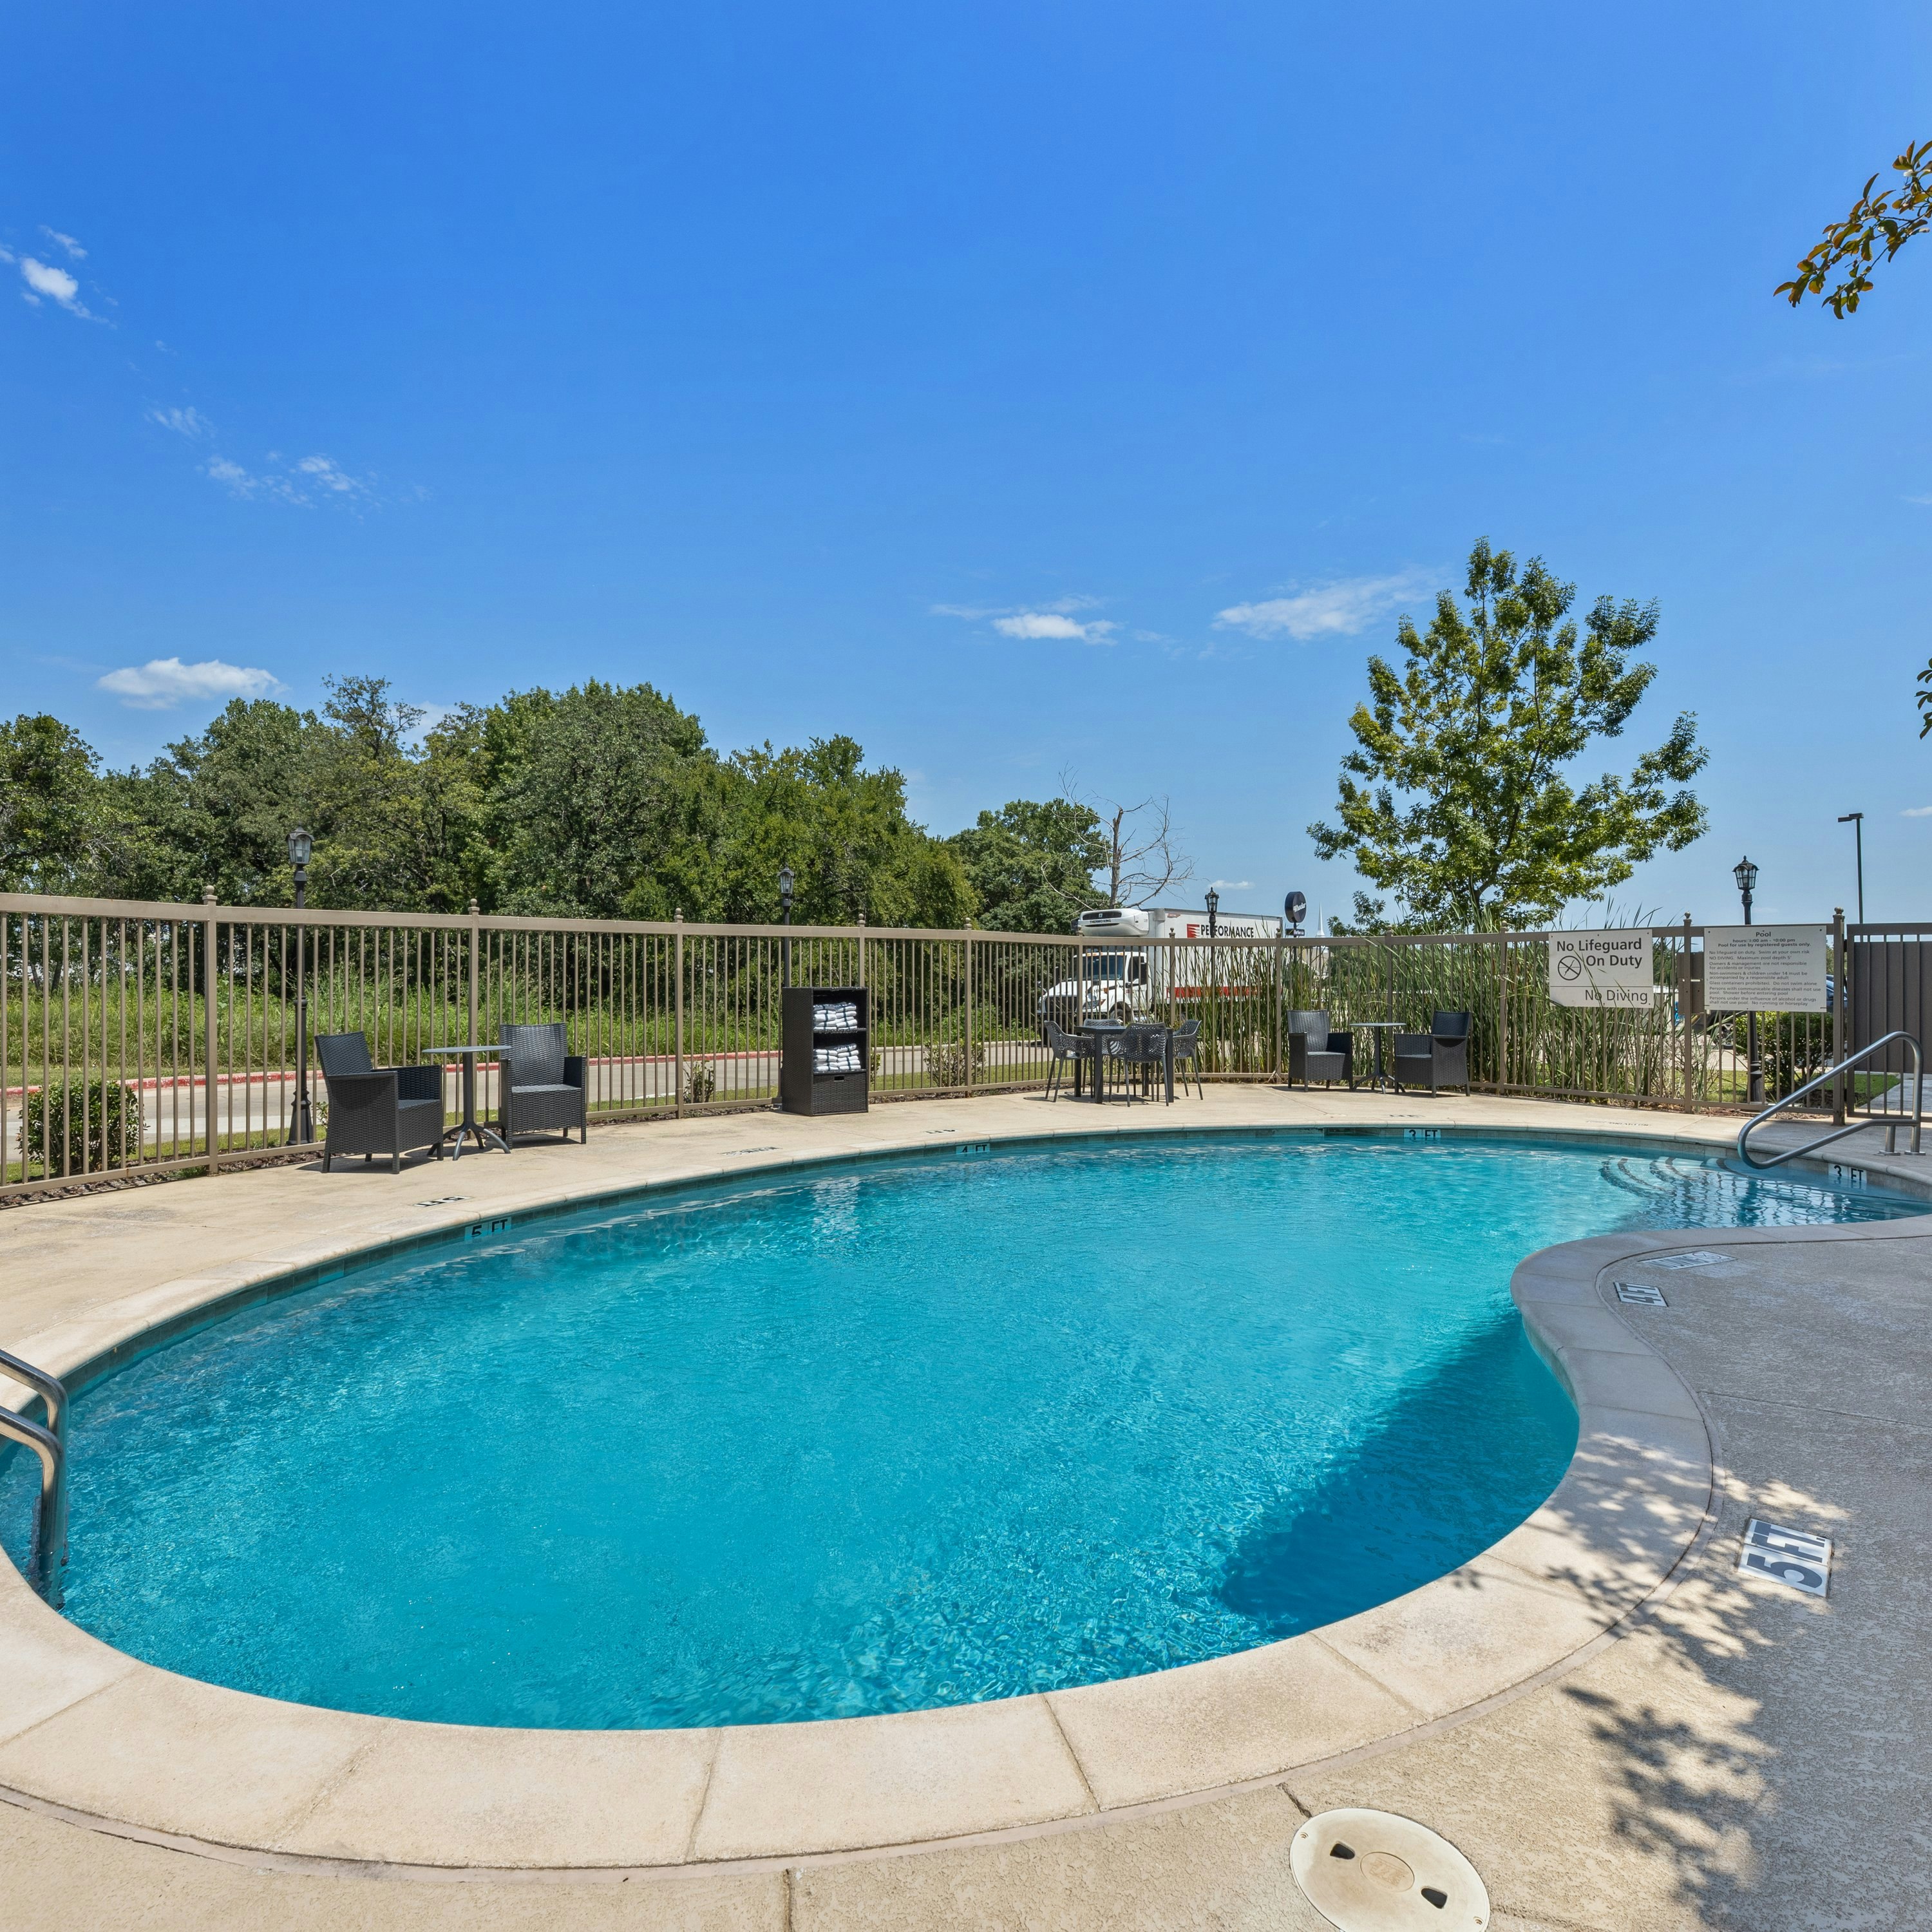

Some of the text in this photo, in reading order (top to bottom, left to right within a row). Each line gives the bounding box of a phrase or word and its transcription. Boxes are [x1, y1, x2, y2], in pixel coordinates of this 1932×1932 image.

[1201, 924, 1254, 938] PEFORMANCE
[1557, 938, 1642, 954] No Lifeguard
[1586, 955, 1642, 969] On Duty
[1586, 990, 1647, 1005] No Diving
[1851, 1168, 1864, 1181] FT
[471, 1225, 482, 1237] 5
[1747, 1553, 1823, 1588] 5
